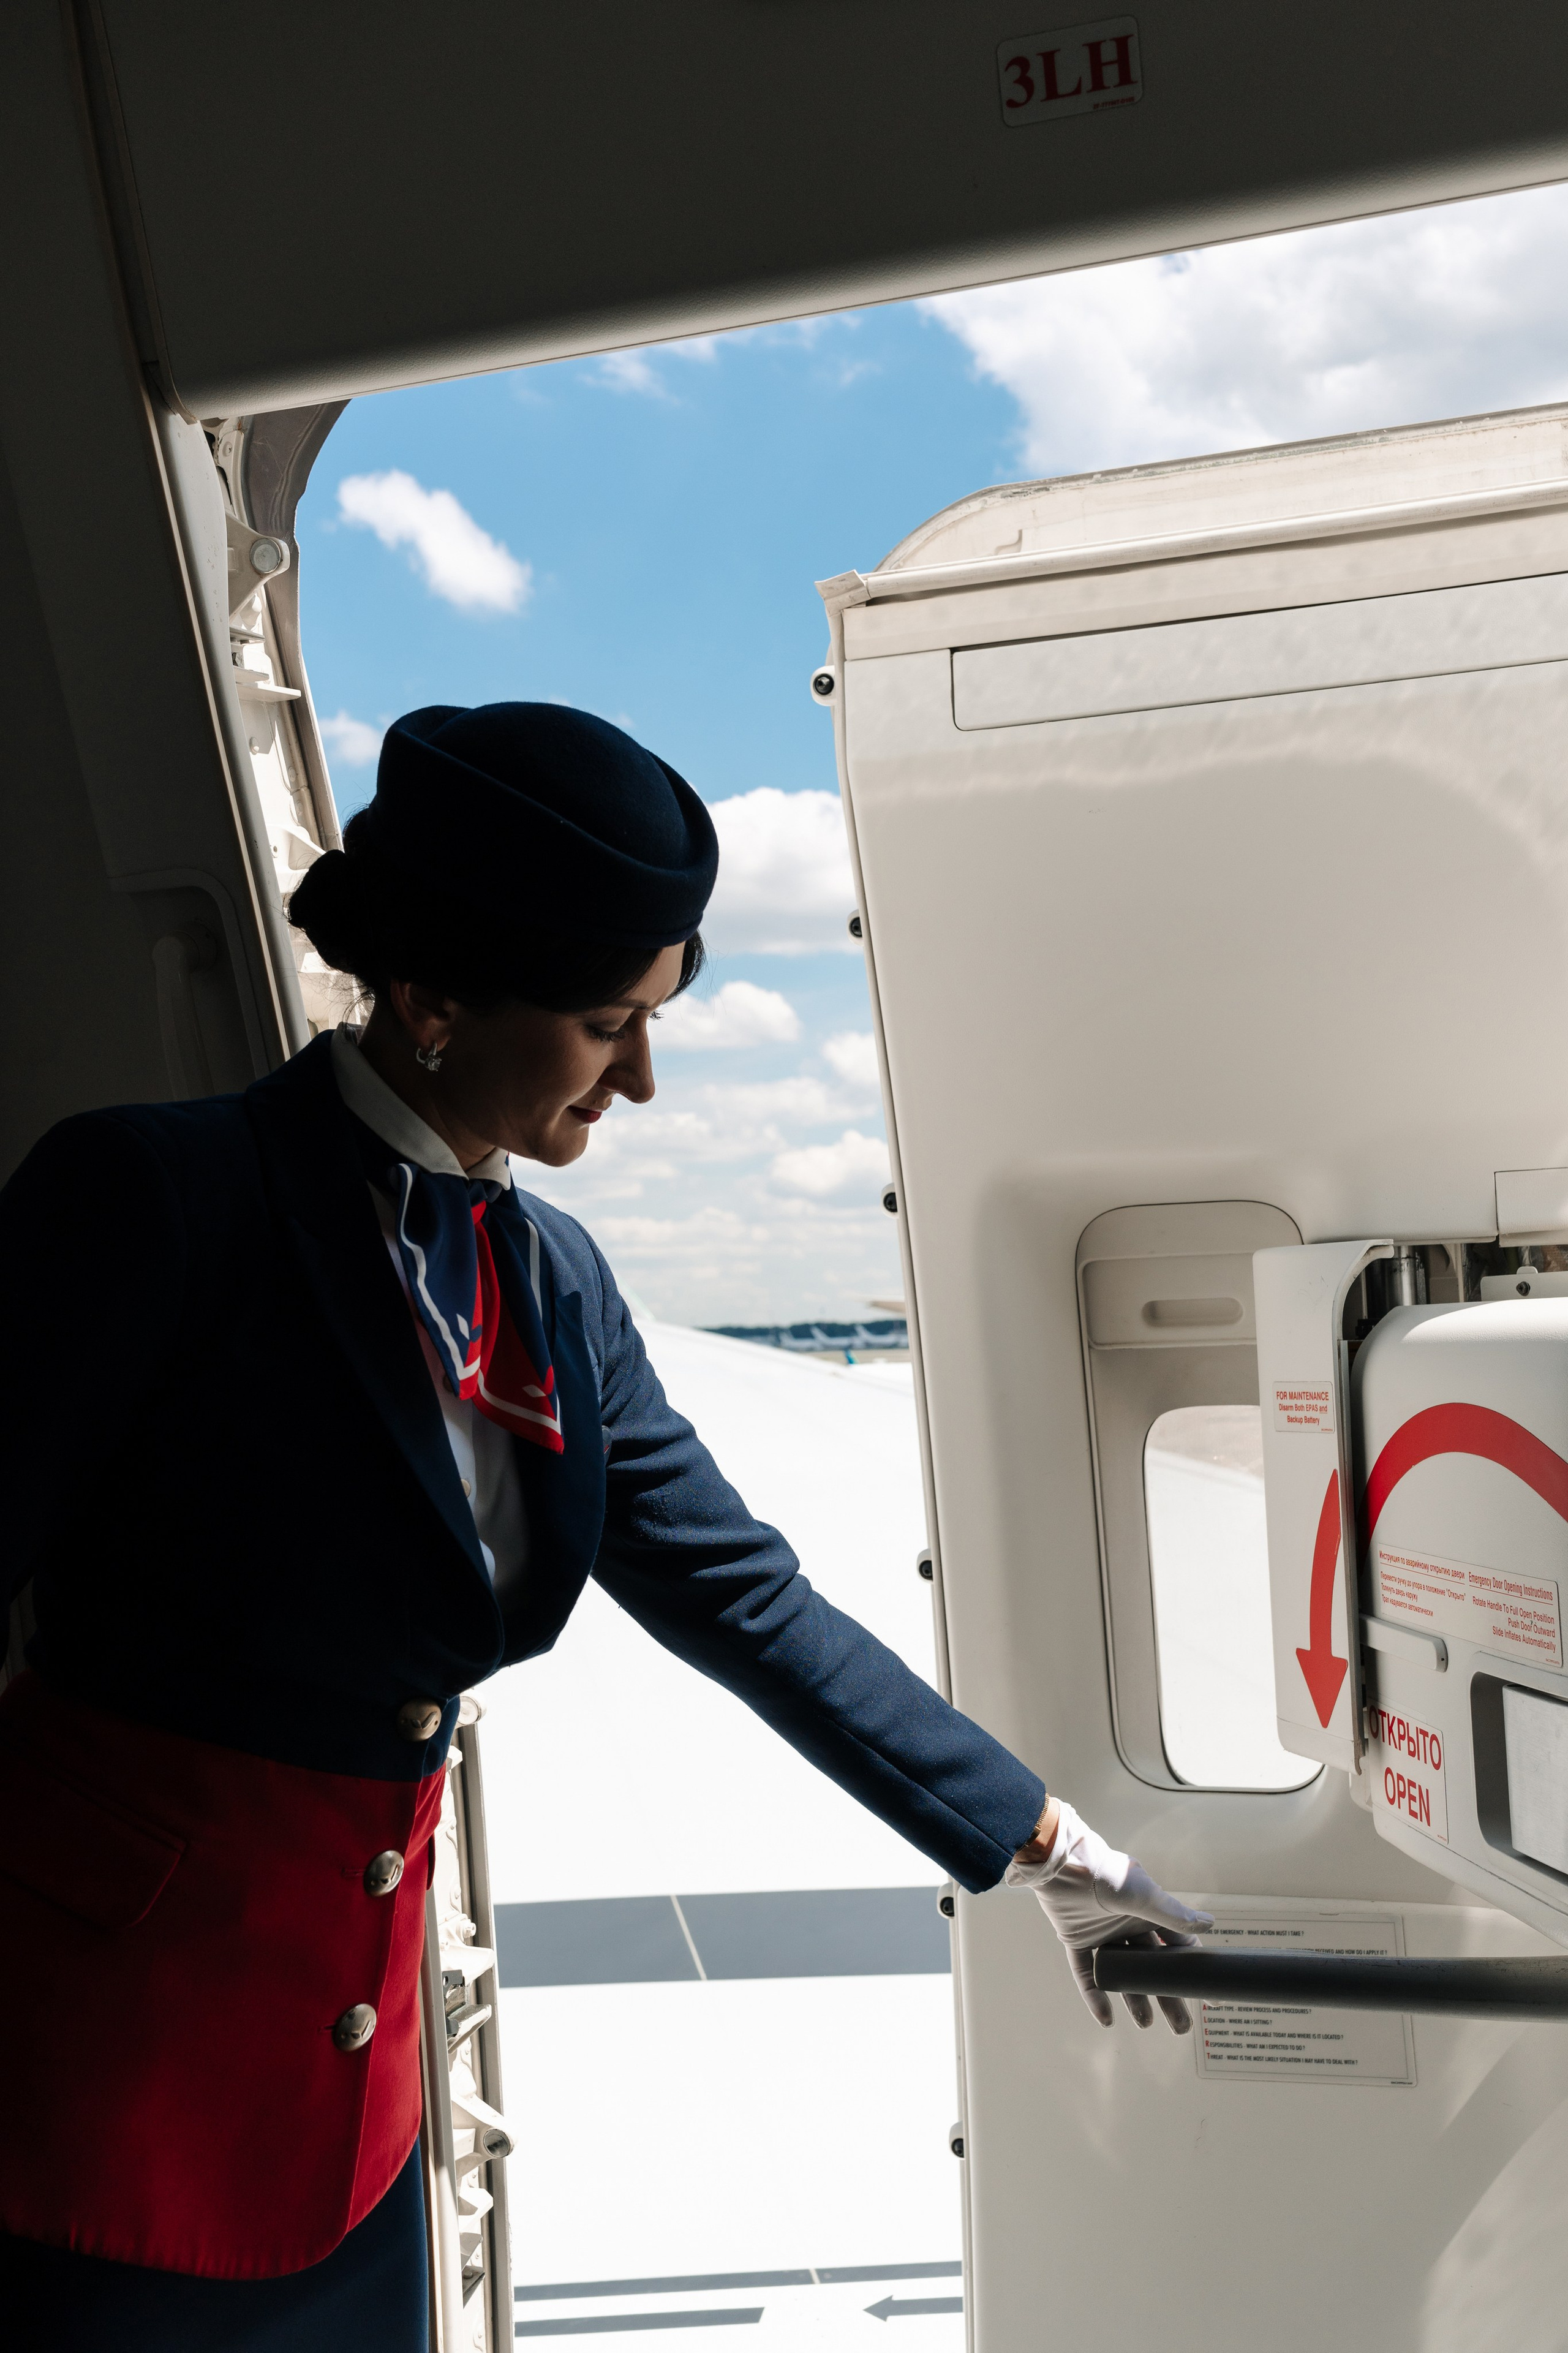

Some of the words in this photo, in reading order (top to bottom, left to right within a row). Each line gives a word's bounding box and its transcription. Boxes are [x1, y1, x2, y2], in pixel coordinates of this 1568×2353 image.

[1005, 34, 1138, 109] 3LH
[1276, 1391, 1287, 1400] FOR
[1289, 1391, 1329, 1401] MAINTENANCE
[1287, 1415, 1303, 1425] Backup
[1304, 1416, 1320, 1426] Battery
[1379, 1550, 1400, 1563] Инструкция
[1406, 1558, 1429, 1573] аварийному
[1430, 1565, 1450, 1576] открытию
[1451, 1569, 1465, 1580] двери
[1381, 1571, 1396, 1582] Перевести
[1397, 1576, 1407, 1587] ручку
[1412, 1581, 1422, 1591] упора
[1426, 1585, 1446, 1596] положение
[1381, 1583, 1395, 1595] Толкнуть
[1395, 1587, 1405, 1597] дверь
[1406, 1590, 1418, 1602] наружу
[1469, 1571, 1491, 1589] Emergency
[1493, 1577, 1502, 1590] Door
[1504, 1579, 1522, 1596] Opening
[1523, 1584, 1553, 1601] Instructions
[1389, 1597, 1408, 1610] надувается
[1408, 1603, 1434, 1617] автоматически
[1472, 1596, 1486, 1607] Rotate
[1487, 1600, 1502, 1611] Handle
[1503, 1603, 1509, 1614] To
[1510, 1606, 1518, 1615] Full
[1519, 1607, 1532, 1620] Open
[1533, 1611, 1555, 1625] Position
[1492, 1625, 1504, 1637] Slide
[1504, 1629, 1521, 1642] Inflates
[1522, 1634, 1556, 1653] Automatically
[1508, 1617, 1520, 1629] Push
[1521, 1620, 1532, 1632] Door
[1534, 1624, 1556, 1638] Outward
[1369, 1705, 1442, 1770] ОТКРЫТО
[1384, 1767, 1431, 1827] OPEN
